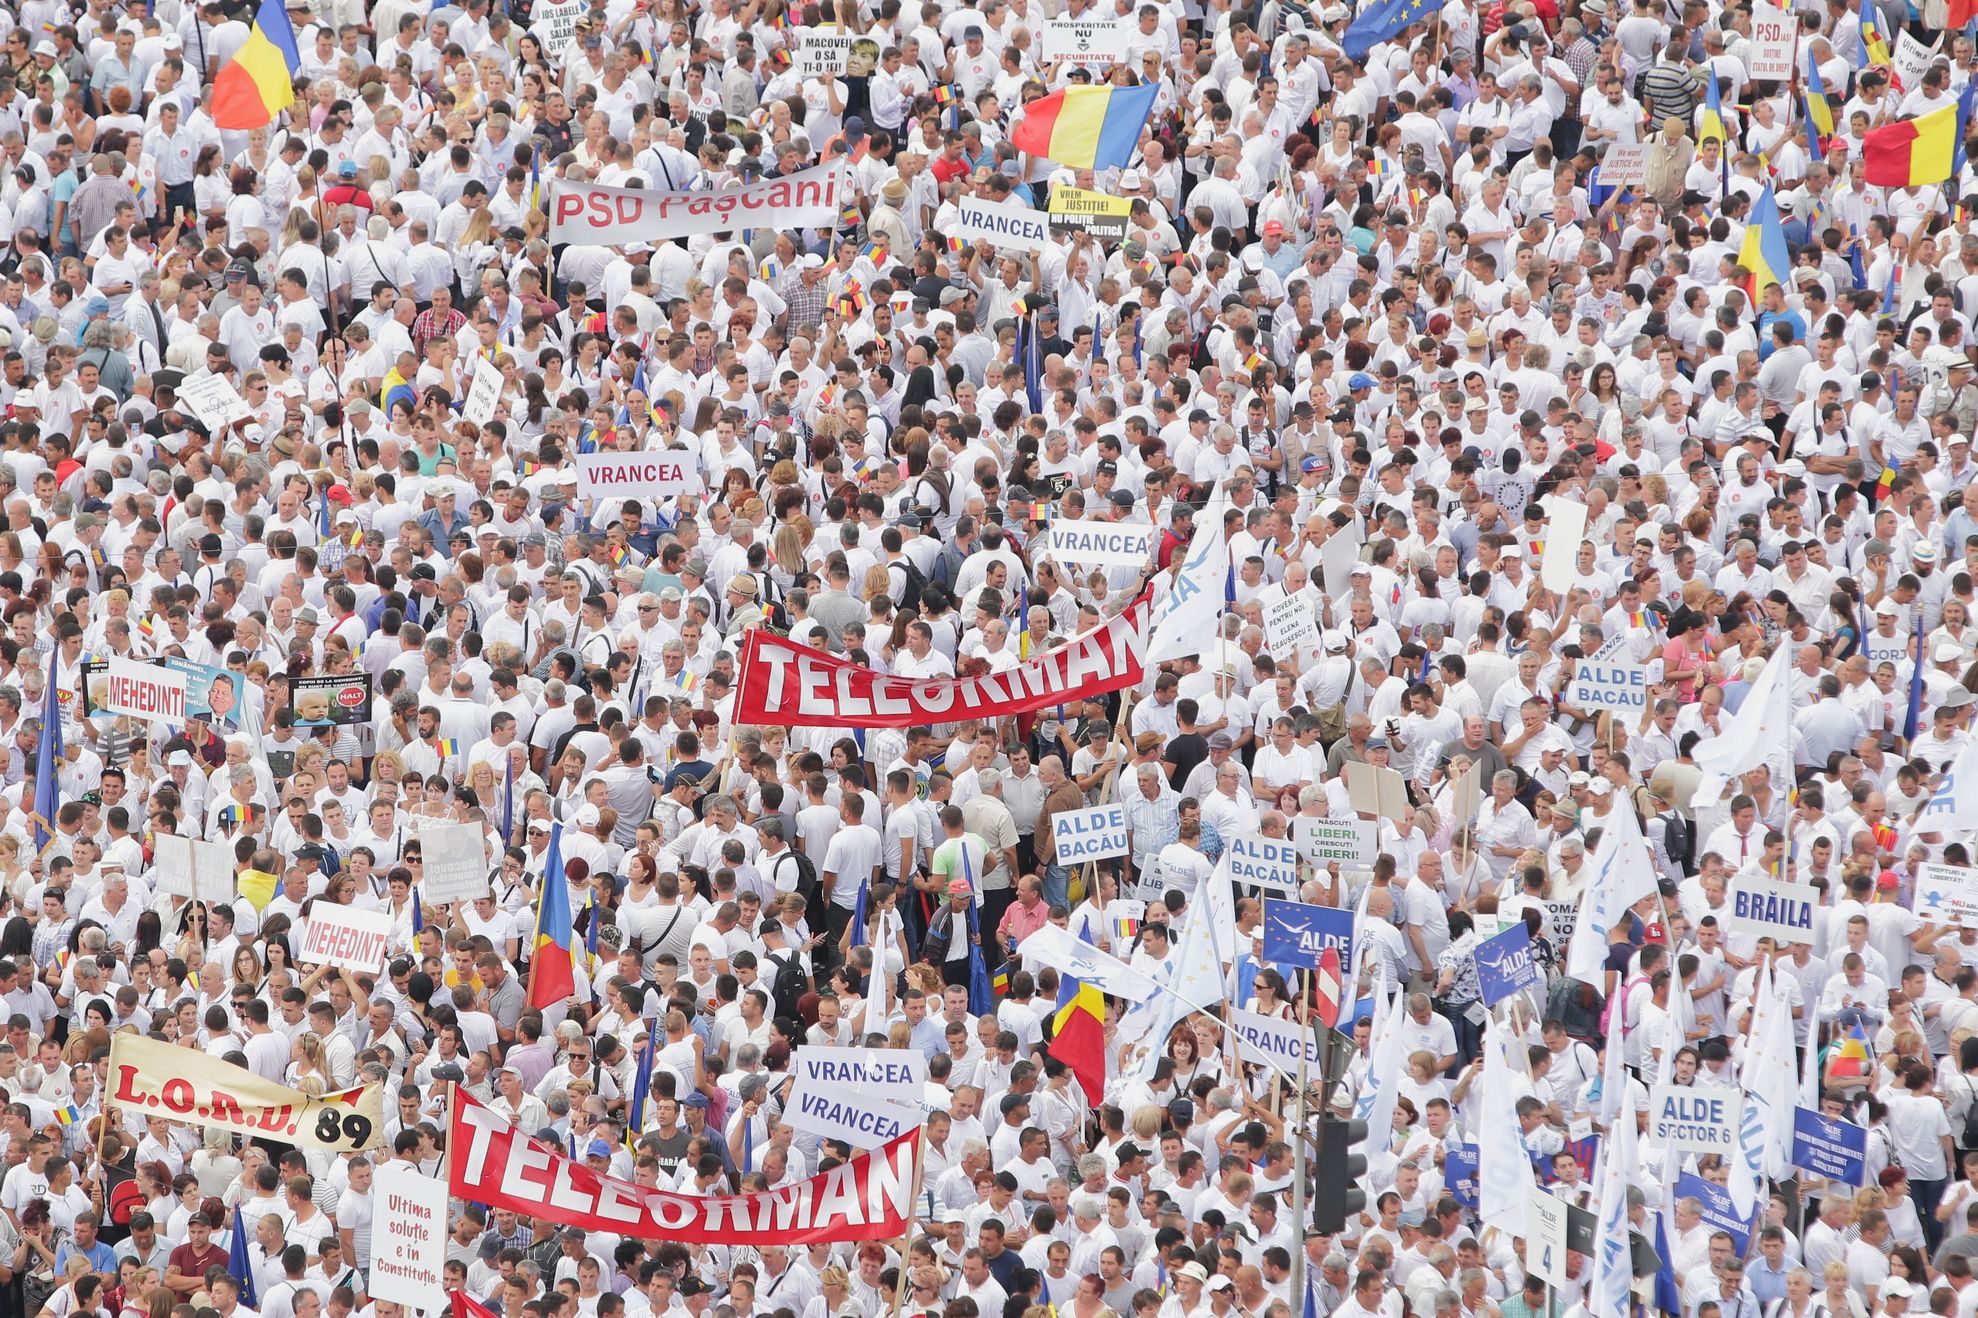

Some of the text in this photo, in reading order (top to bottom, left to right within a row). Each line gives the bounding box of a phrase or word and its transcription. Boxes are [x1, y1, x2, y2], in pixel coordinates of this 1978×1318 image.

[556, 5, 580, 17] LABELE
[553, 17, 572, 28] DE PE
[550, 28, 576, 39] SALARI
[1075, 30, 1092, 38] NU
[1756, 23, 1781, 41] PSD
[815, 51, 822, 60] O
[1903, 39, 1928, 60] Ultima
[1627, 149, 1642, 157] want
[1608, 160, 1632, 168] JUSTICE
[556, 172, 836, 228] PSD Pașcani
[1060, 190, 1082, 199] VREM
[1065, 200, 1109, 213] JUSTIȚIE!
[961, 208, 1045, 241] VRANCEA
[1051, 214, 1095, 227] NU POLIȚIE
[1086, 224, 1123, 237] POLITICĂ
[588, 464, 684, 485] VRANCEA
[1053, 531, 1148, 554] VRANCEA
[1272, 598, 1294, 614] KOVESI
[1269, 612, 1294, 628] PENTRU
[1280, 620, 1299, 635] ELENA
[1271, 628, 1306, 651] CEAUSESCU
[758, 600, 1150, 716] TELEORMAN
[1870, 649, 1908, 661] GORJ
[1578, 666, 1643, 686] ALDE
[109, 675, 185, 718] MEHEDINTI
[340, 692, 362, 700] HALT
[1578, 688, 1645, 706] BACĂU
[1056, 809, 1123, 837] ALDE
[1318, 819, 1352, 827] NĂSCUȚI
[1310, 828, 1360, 842] LIBERI,
[1315, 840, 1352, 848] CRESCUȚI
[1058, 833, 1126, 858] BACĂU
[1232, 838, 1294, 864] ALDE
[1312, 849, 1359, 860] LIBERI!
[1169, 863, 1189, 876] ALDE
[1232, 860, 1295, 885] BACĂU
[1735, 890, 1812, 929] BRĂILA
[304, 920, 389, 966] MEHEDINTI
[1300, 931, 1350, 950] ALDE
[1502, 947, 1533, 978] ALDE
[807, 1060, 913, 1084] VRANCEA
[114, 1065, 372, 1149] L.O.R.D. 89
[801, 1093, 900, 1139] VRANCEA
[1663, 1096, 1724, 1124] ALDE
[1658, 1123, 1731, 1143] SECTOR 6
[1825, 1124, 1842, 1137] ALDE
[1459, 1150, 1478, 1160] ALDE
[461, 1103, 913, 1233] TELEORMAN
[389, 1194, 431, 1219] Ultima
[1712, 1194, 1732, 1207] ALDE
[1541, 1208, 1557, 1225] ALDE
[389, 1220, 429, 1244] soluție
[396, 1244, 419, 1260] e în
[1542, 1245, 1552, 1276] 4
[377, 1257, 436, 1287] Constituție
